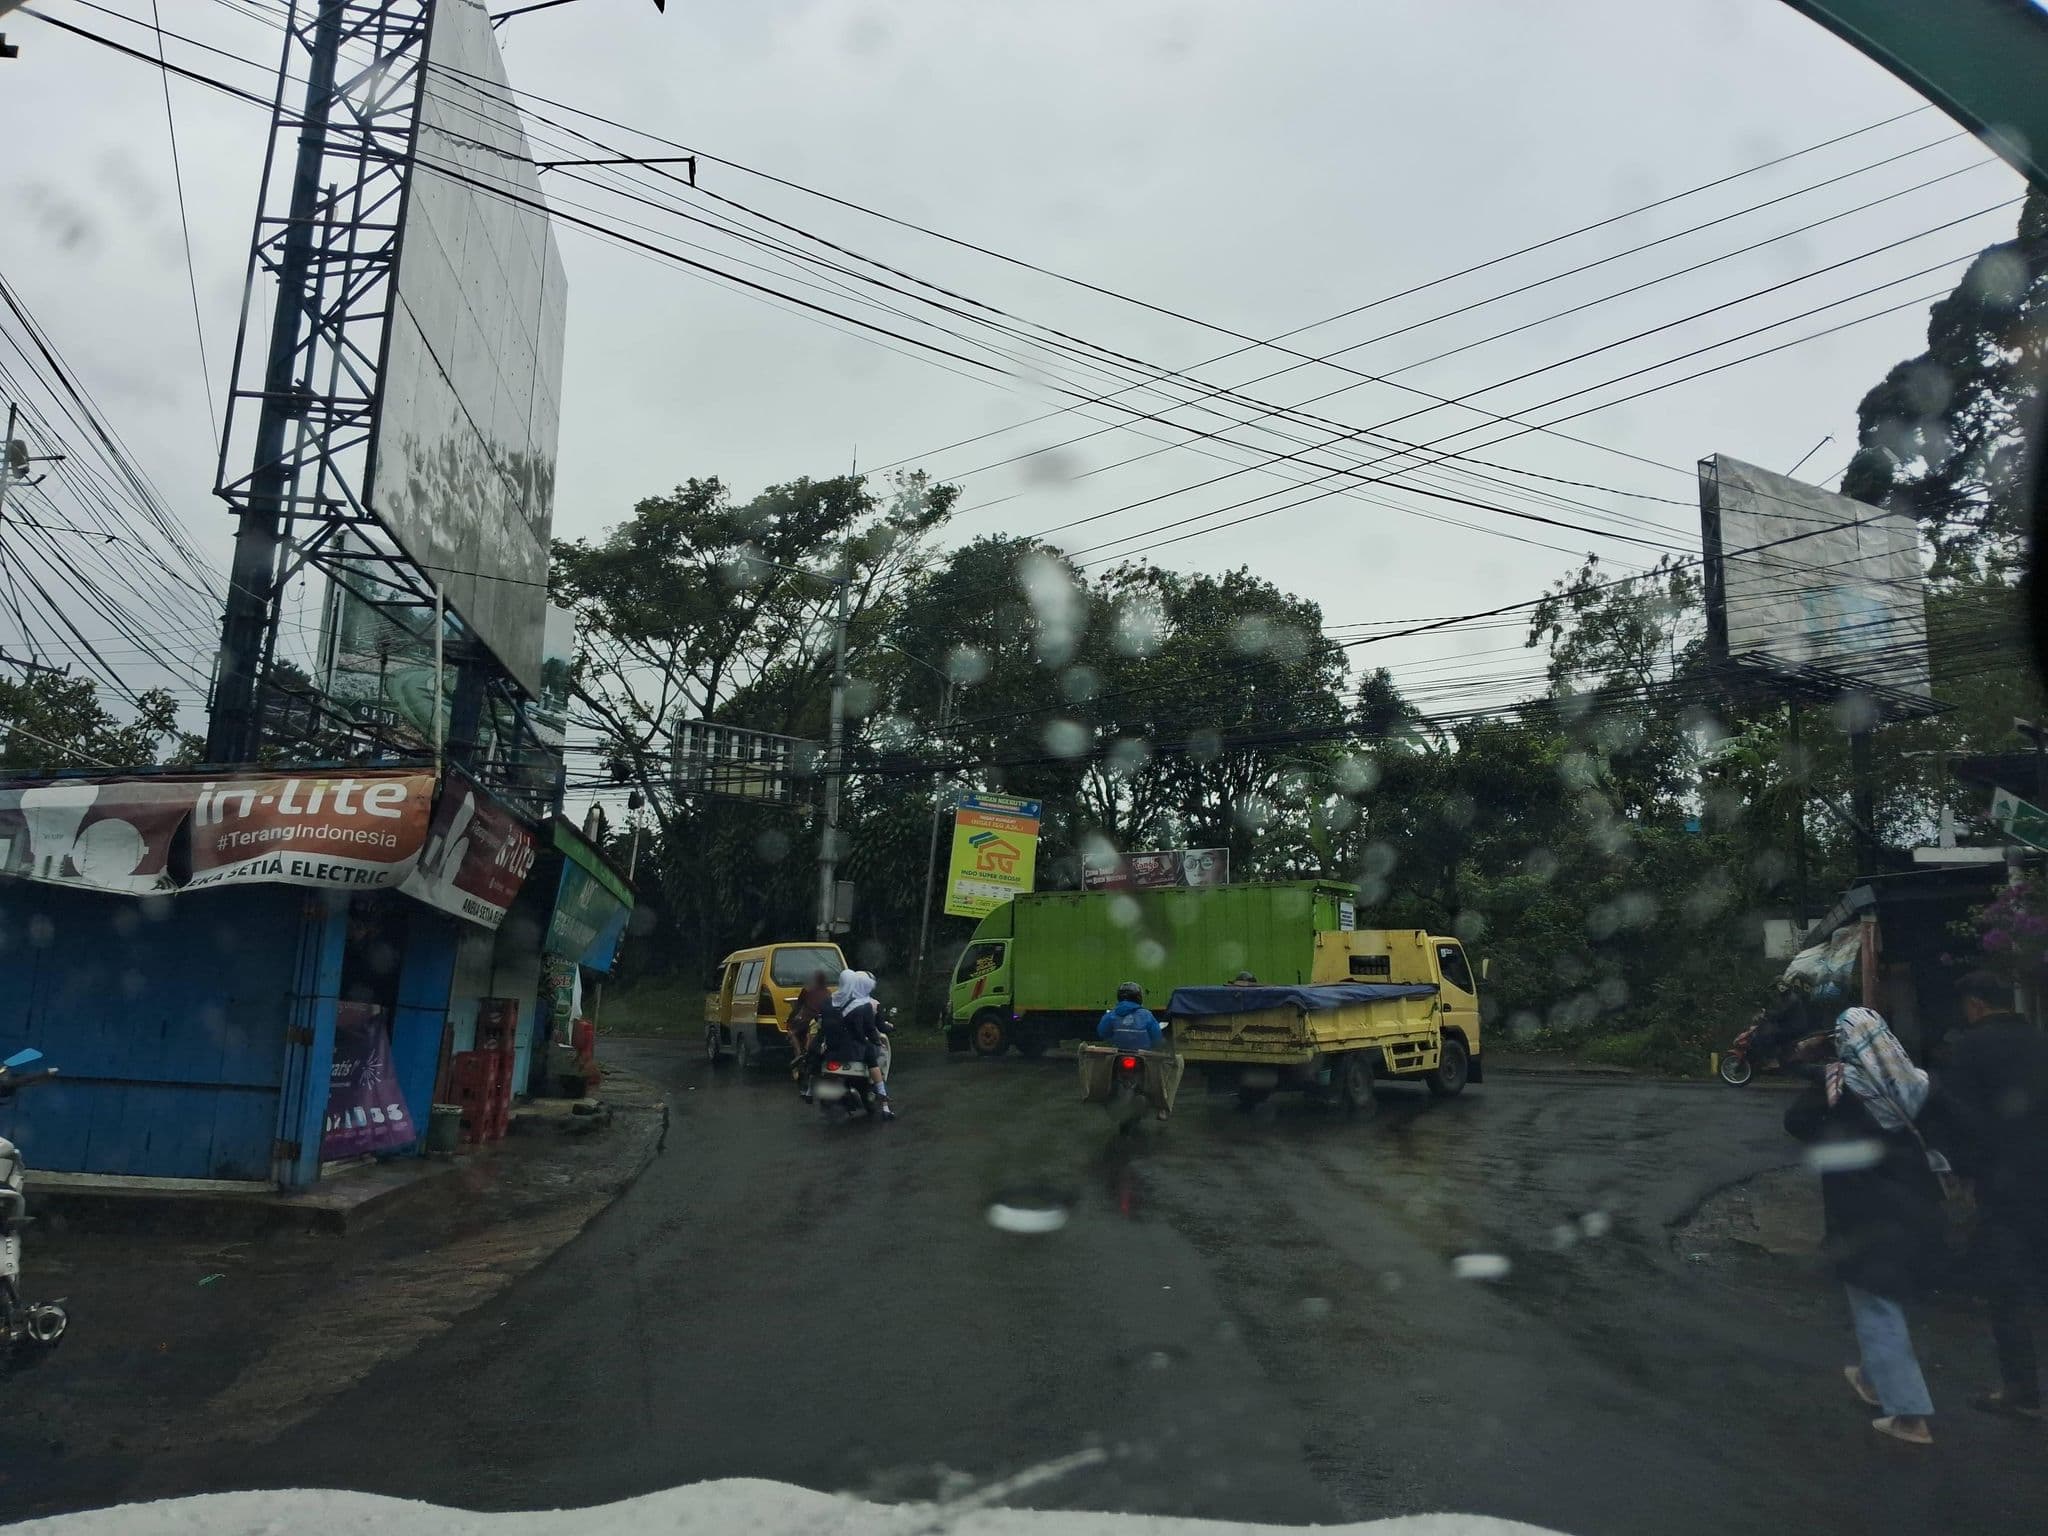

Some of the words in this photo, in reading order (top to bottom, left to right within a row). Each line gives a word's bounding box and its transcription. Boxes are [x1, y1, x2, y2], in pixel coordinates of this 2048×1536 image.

[216, 823, 398, 850] #TerangIndonesia
[227, 858, 283, 878] SETIA
[290, 859, 389, 885] ELECTRIC
